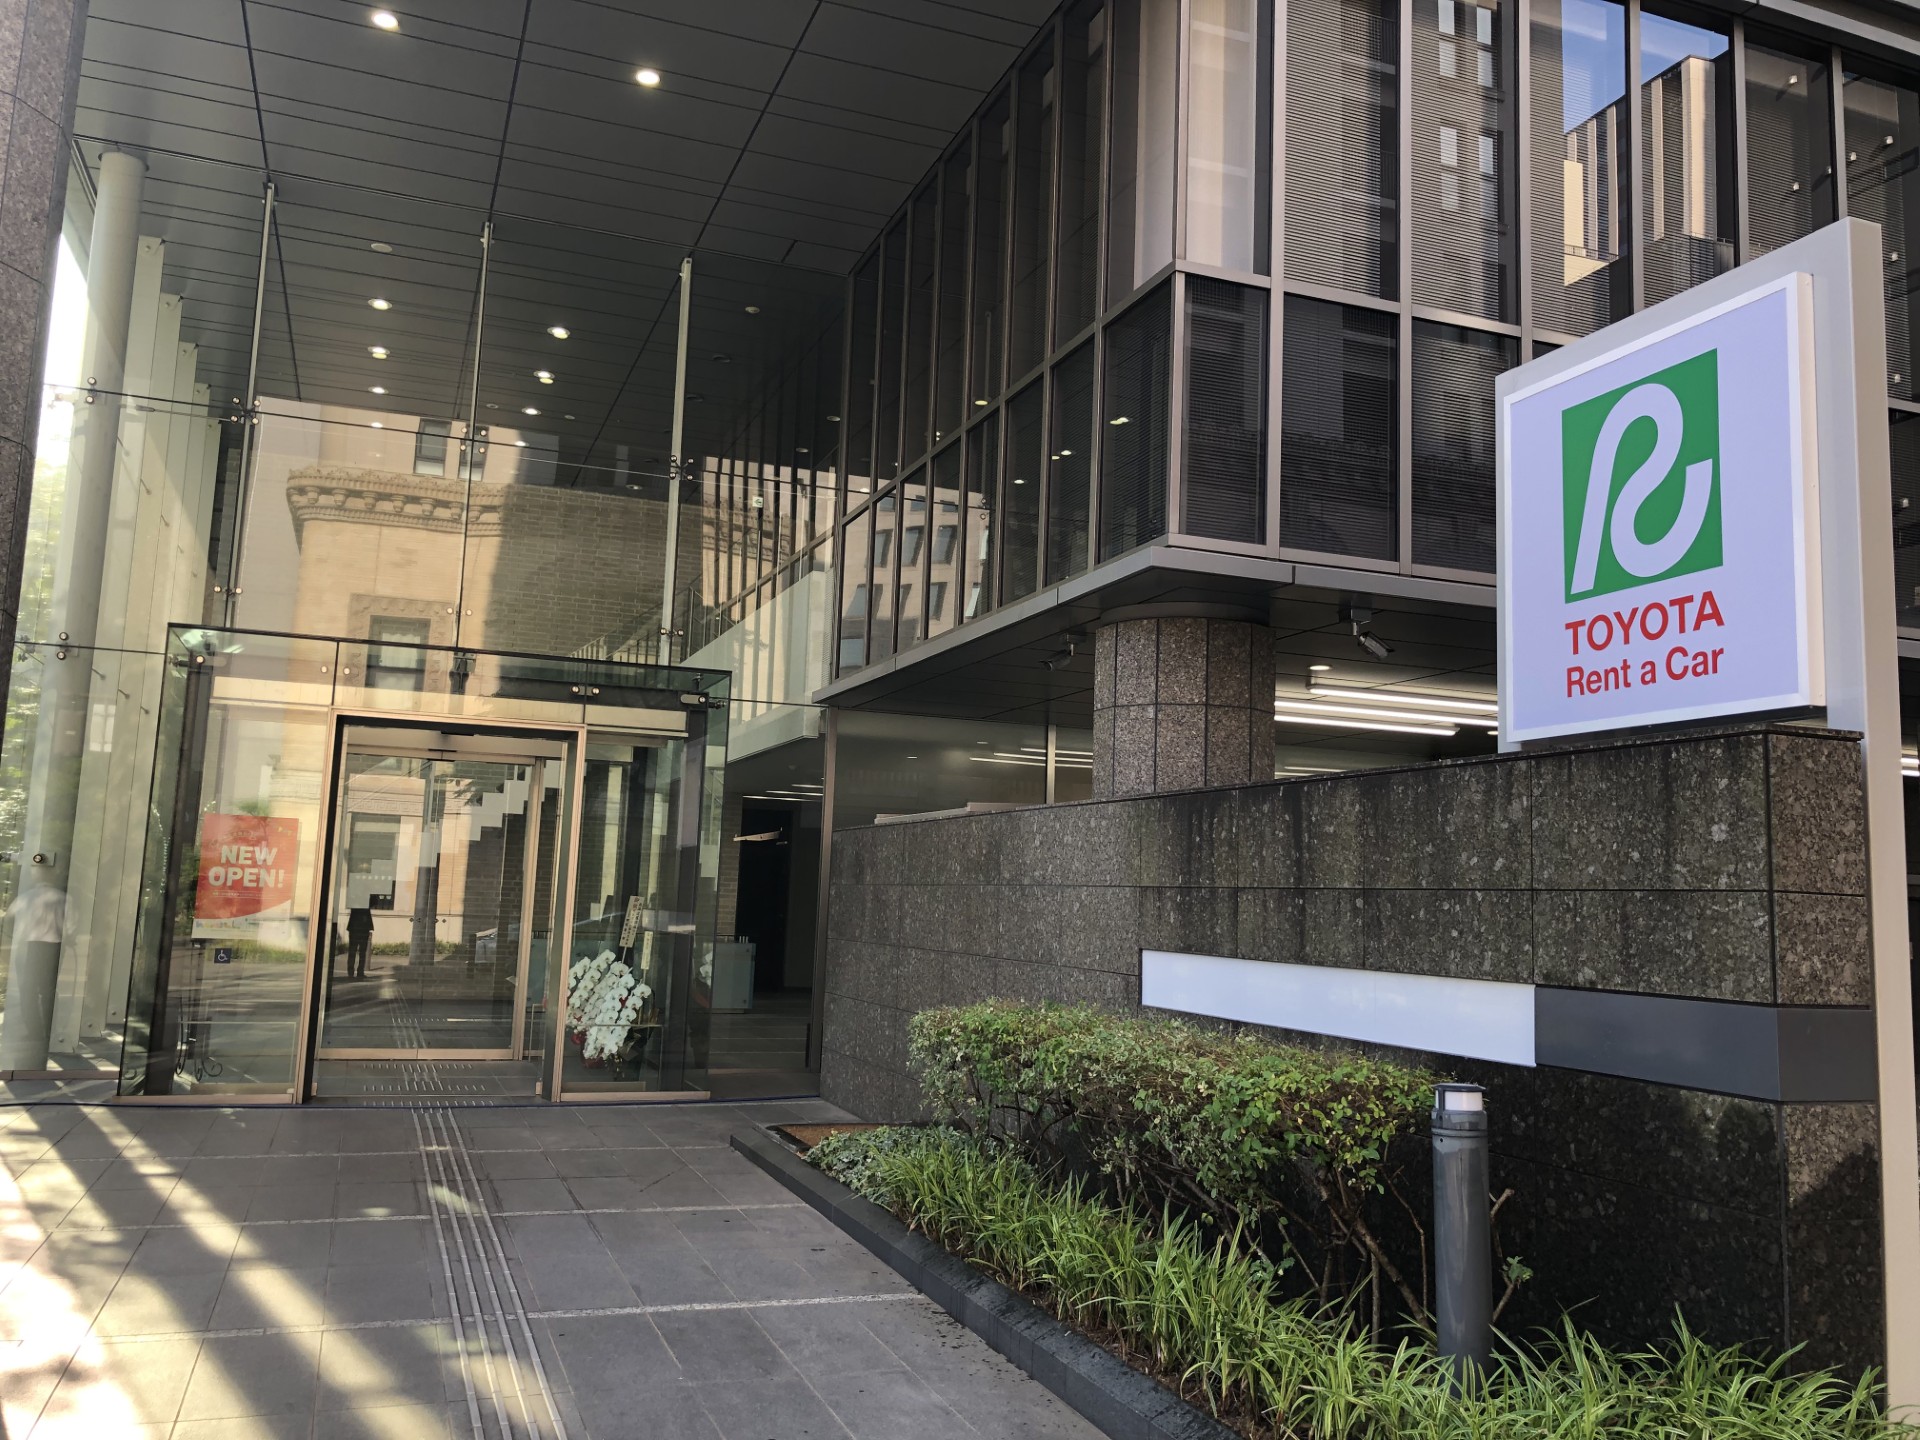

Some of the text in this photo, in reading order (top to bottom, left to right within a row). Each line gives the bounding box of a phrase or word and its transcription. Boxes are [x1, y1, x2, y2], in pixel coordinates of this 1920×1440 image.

[1565, 591, 1725, 655] TOYOTA
[1566, 646, 1725, 698] Rent a Car
[220, 845, 278, 866] NEW
[208, 866, 286, 888] OPEN!
